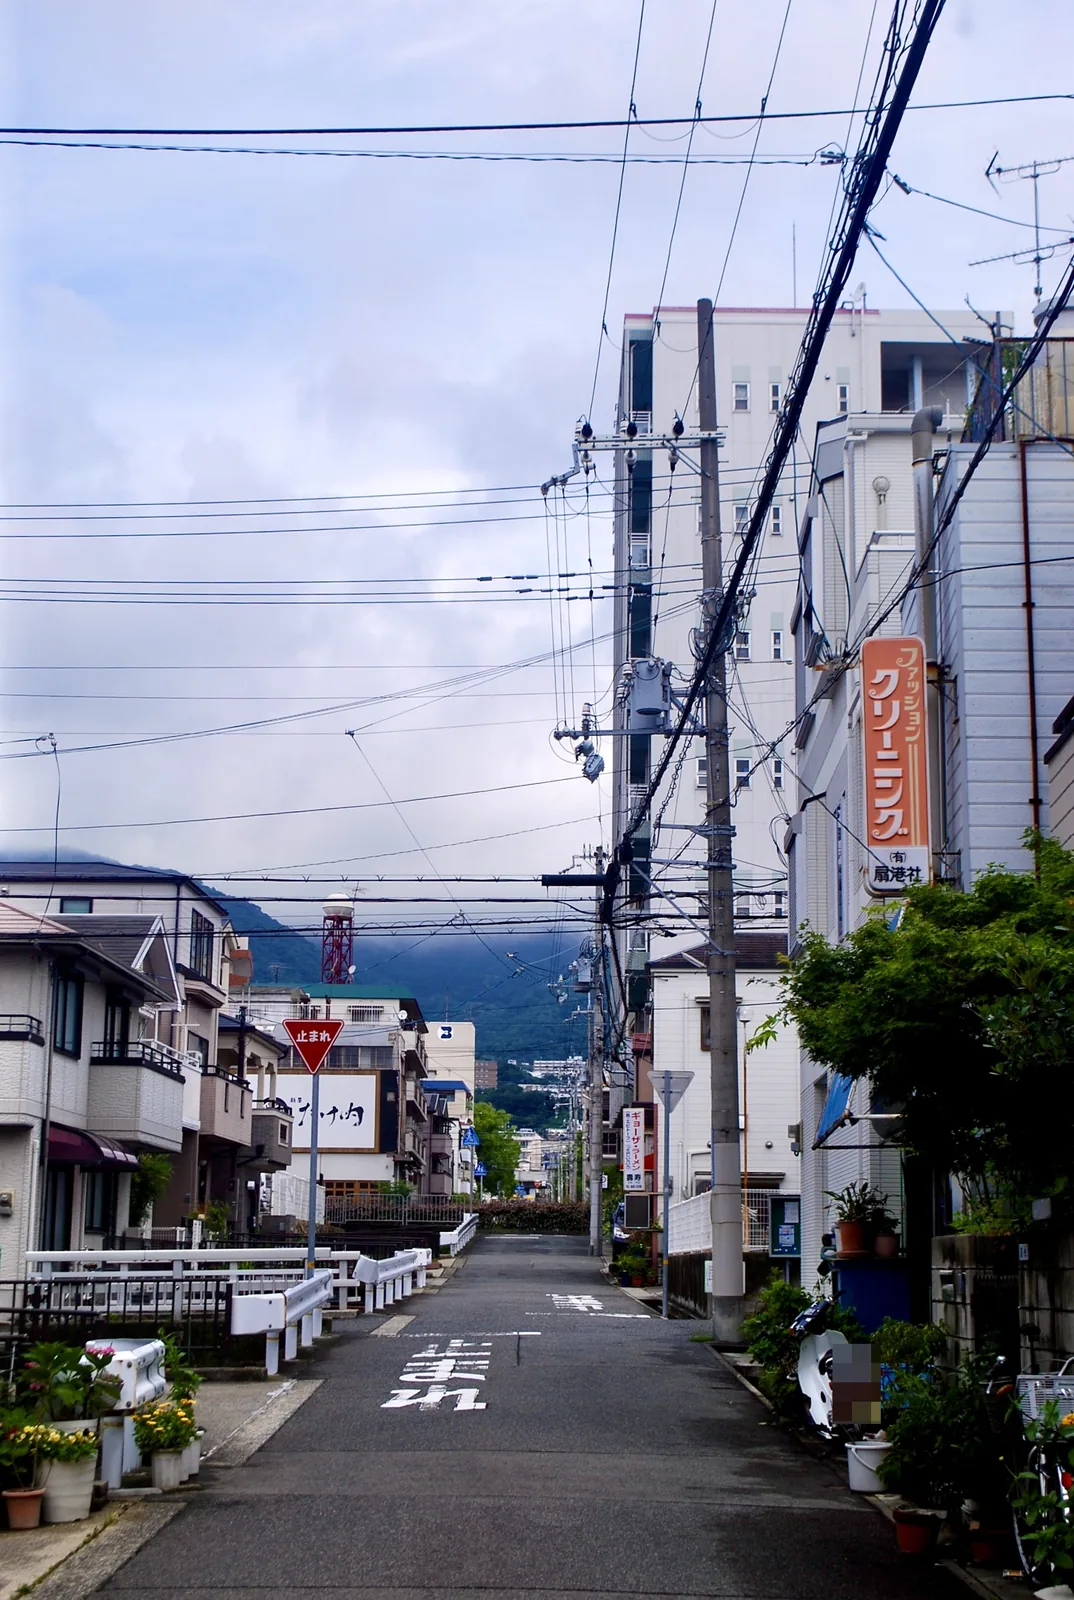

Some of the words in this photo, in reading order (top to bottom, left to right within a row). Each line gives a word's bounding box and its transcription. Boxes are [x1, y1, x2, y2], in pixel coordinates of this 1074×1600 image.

[896, 648, 921, 742] ファッション
[869, 669, 909, 841] クリーニング
[874, 866, 921, 882] 扇港社
[296, 1030, 331, 1042] 止まれ
[631, 1111, 641, 1171] ギョーザ・ラーメン
[380, 1340, 492, 1411] 止まれ
